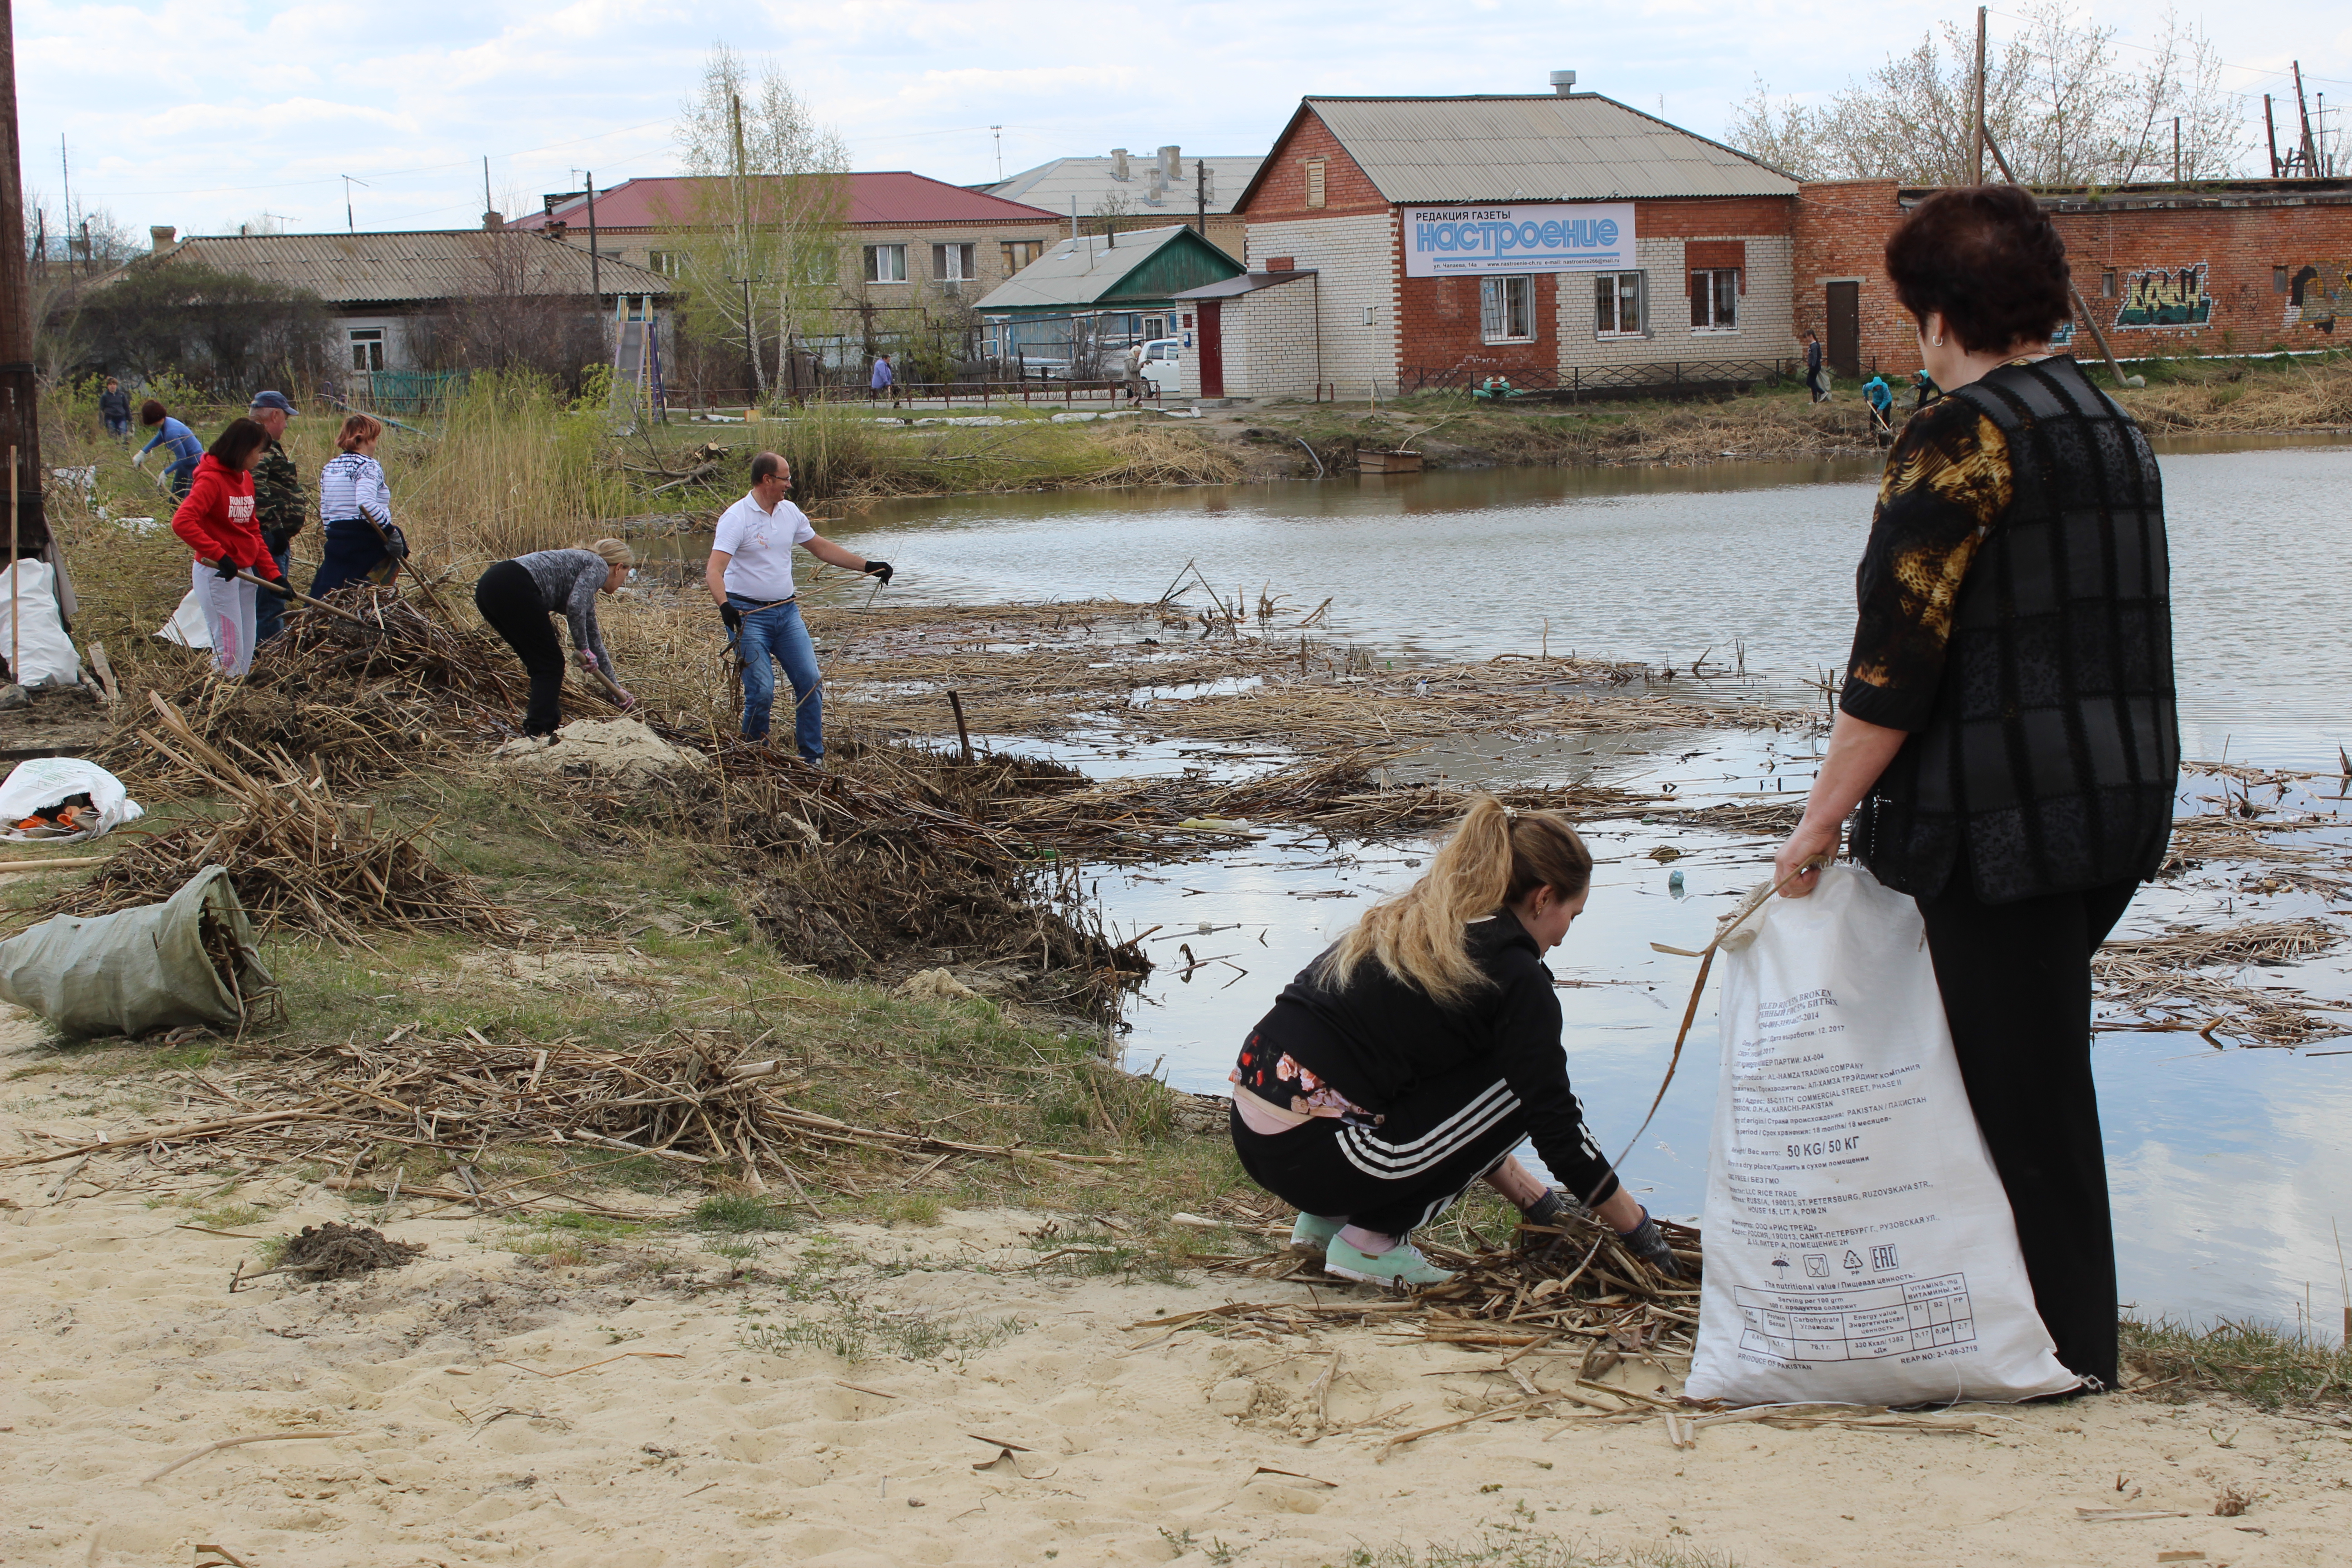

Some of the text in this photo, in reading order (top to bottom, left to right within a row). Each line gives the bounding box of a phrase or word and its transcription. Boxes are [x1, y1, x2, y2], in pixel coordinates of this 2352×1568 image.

[1416, 211, 1510, 221] РЕДАКЦИЯ ГАЗЕТЫ
[1799, 989, 1833, 1001] BROKEN
[1808, 998, 1838, 1008] БИТЫХ
[1783, 1030, 1817, 1040] выработки:
[1774, 1057, 1802, 1066] ПАРТИИ:
[1768, 1071, 1800, 1081] AL-HAMZA
[1801, 1067, 1829, 1078] TRADING
[1830, 1063, 1864, 1073] COMPANY
[1808, 1077, 1841, 1089] АЛ-ХАМЗА
[1842, 1073, 1880, 1082] ТРЭЙДИНГ
[1797, 1090, 1840, 1103] COMMERCIAL
[1842, 1085, 1871, 1096] STREET,
[1872, 1080, 1896, 1090] PHASE
[1772, 1101, 1833, 1112] KARACHI-PAKISTAN
[1790, 1113, 1844, 1125] происхождения:
[1847, 1104, 1883, 1116] PAKISTAN
[1889, 1097, 1927, 1108] ПАКИСТАН
[1787, 1145, 1800, 1157] 50
[1828, 1139, 1841, 1153] 50
[1807, 1161, 1827, 1171] сухом
[1828, 1156, 1870, 1167] помещении
[1747, 1197, 1769, 1206] RUSSIA,
[1809, 1193, 1861, 1205] PETERSBURG,
[1862, 1183, 1912, 1199] RUZOVSKAYA
[1748, 1206, 1766, 1215] HOUSE
[1747, 1230, 1770, 1240] РОССИЯ,
[1799, 1226, 1869, 1240] САНКТ-ПЕТЕРБУРГ
[1879, 1216, 1924, 1231] РУЗОВСКАЯ
[1755, 1222, 1768, 1230] ООО
[1790, 1224, 1817, 1232] ТРЕЙД»
[1760, 1240, 1779, 1248] ЛИТЕР
[1790, 1240, 1838, 1249] ПОМЕЩЕНИЕ
[1776, 1281, 1814, 1291] nutritional
[1841, 1280, 1876, 1290] Пищевая
[1877, 1272, 1916, 1284] ценность:
[1910, 1281, 1947, 1292] VITAMINS,
[1908, 1287, 1952, 1299] ВИТАМИНЫ,
[1778, 1296, 1803, 1304] Serving
[1767, 1312, 1786, 1321] Protein
[1853, 1313, 1877, 1321] Energy
[1861, 1326, 1894, 1335] ценность
[1935, 1326, 1950, 1335] 0,04
[1901, 1356, 1921, 1364] REAP
[1937, 1345, 1978, 1358] 2-1-06-3719
[1738, 1353, 1766, 1366] PRODUCE
[1777, 1362, 1812, 1370] PAKISTAN
